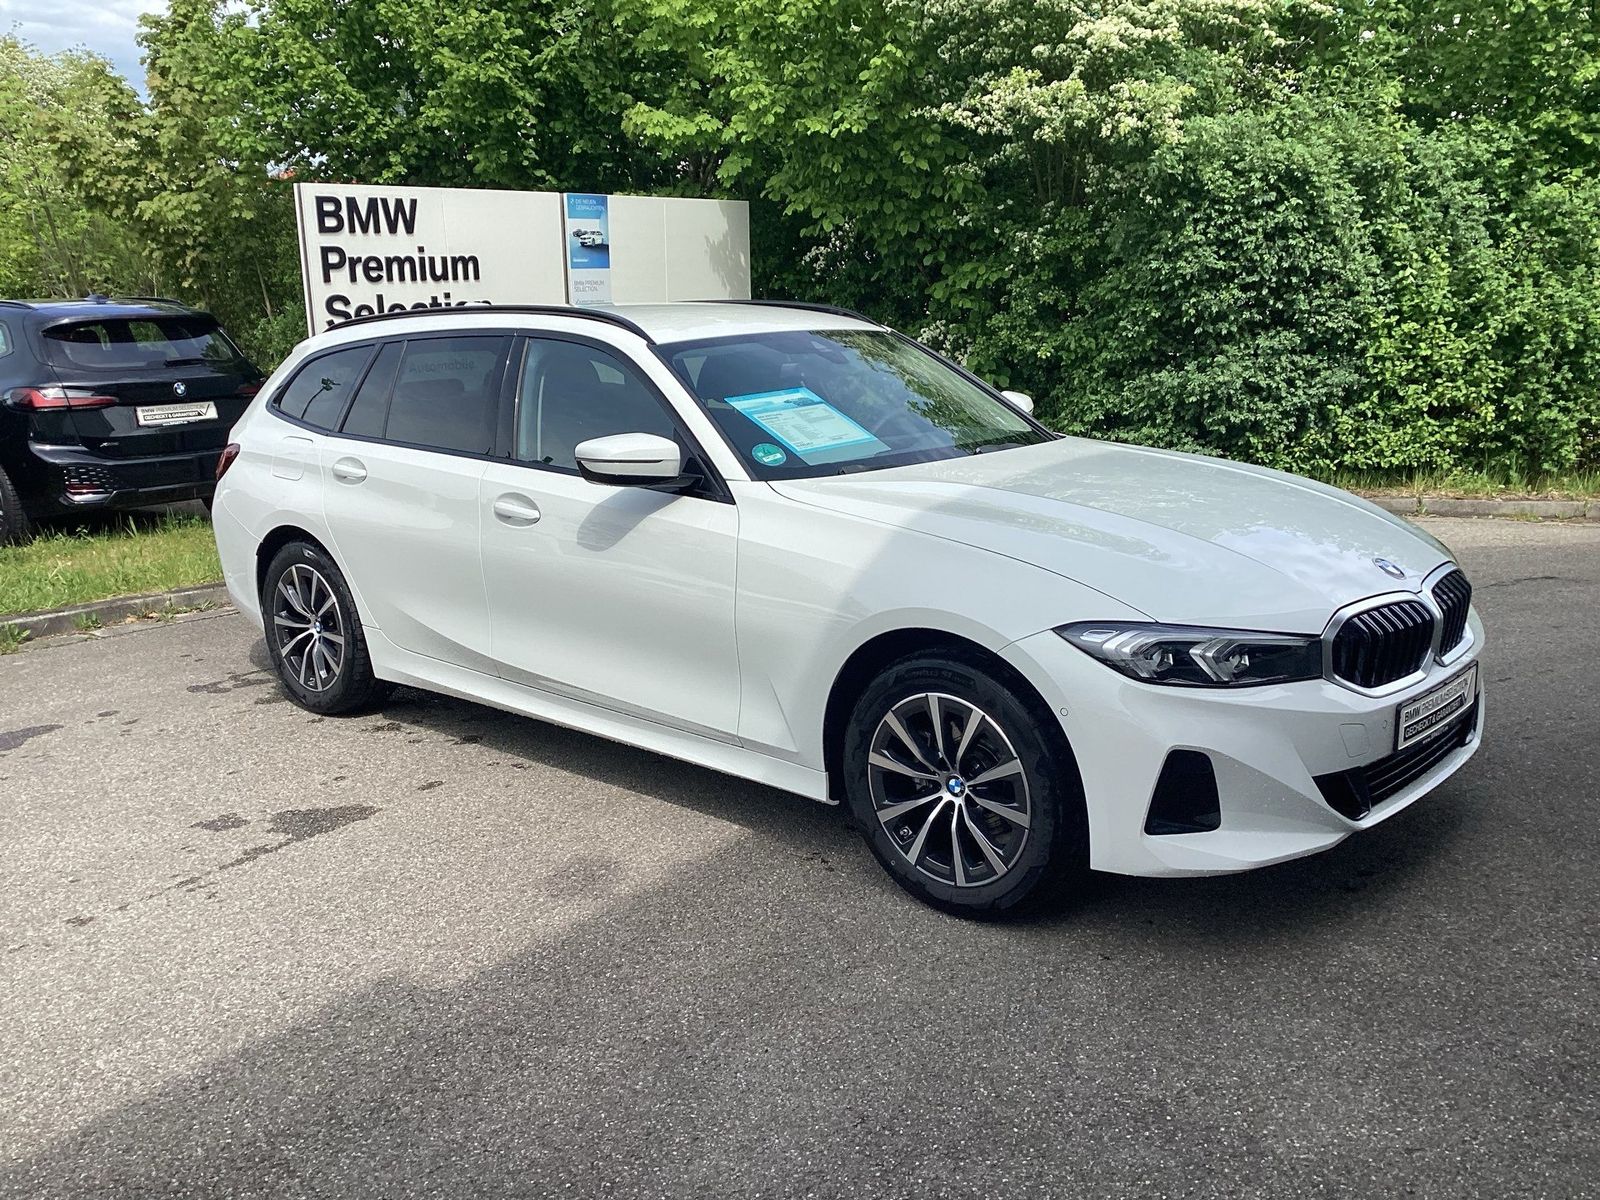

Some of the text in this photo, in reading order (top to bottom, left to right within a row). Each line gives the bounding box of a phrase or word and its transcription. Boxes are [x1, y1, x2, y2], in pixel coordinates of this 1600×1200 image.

[315, 196, 418, 235] BMW
[320, 246, 480, 283] Premium
[1404, 705, 1421, 723] BMW
[1405, 715, 1432, 738] GECHECKT
